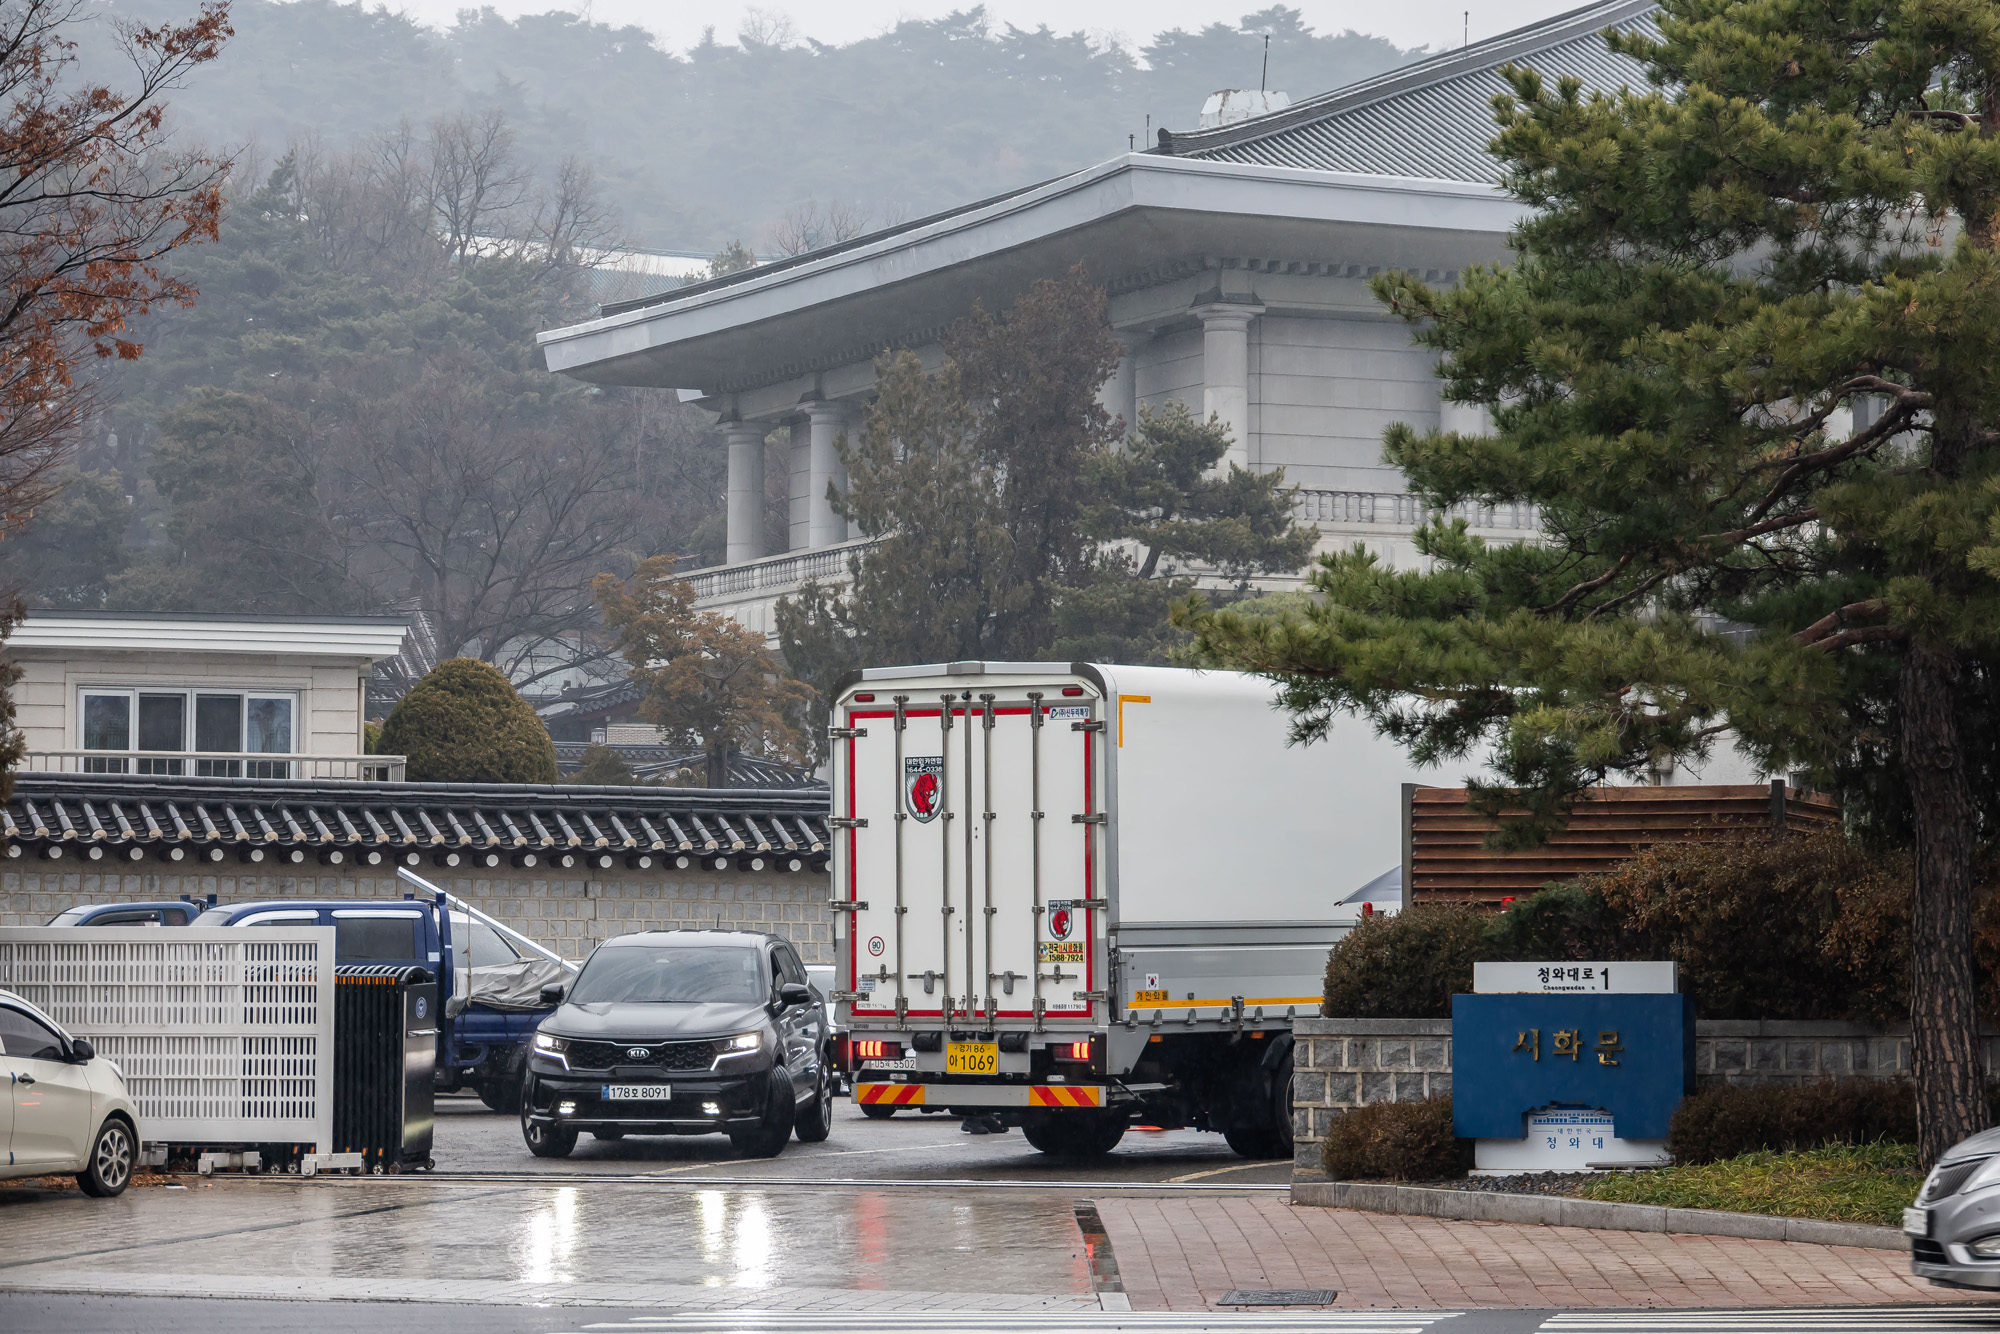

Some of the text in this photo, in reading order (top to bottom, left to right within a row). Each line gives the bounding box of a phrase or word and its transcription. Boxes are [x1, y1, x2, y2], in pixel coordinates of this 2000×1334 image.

[872, 941, 881, 950] 90
[1048, 954, 1084, 962] 1588-7924
[1537, 967, 1609, 990] 청와대로 1
[1136, 990, 1168, 1002] 개인화물
[959, 1044, 985, 1053] 경기 86
[1512, 1028, 1624, 1066] 시화문
[893, 1059, 915, 1069] 5502
[611, 1087, 667, 1098] 178호 8091
[1546, 1136, 1604, 1149] 청와대
